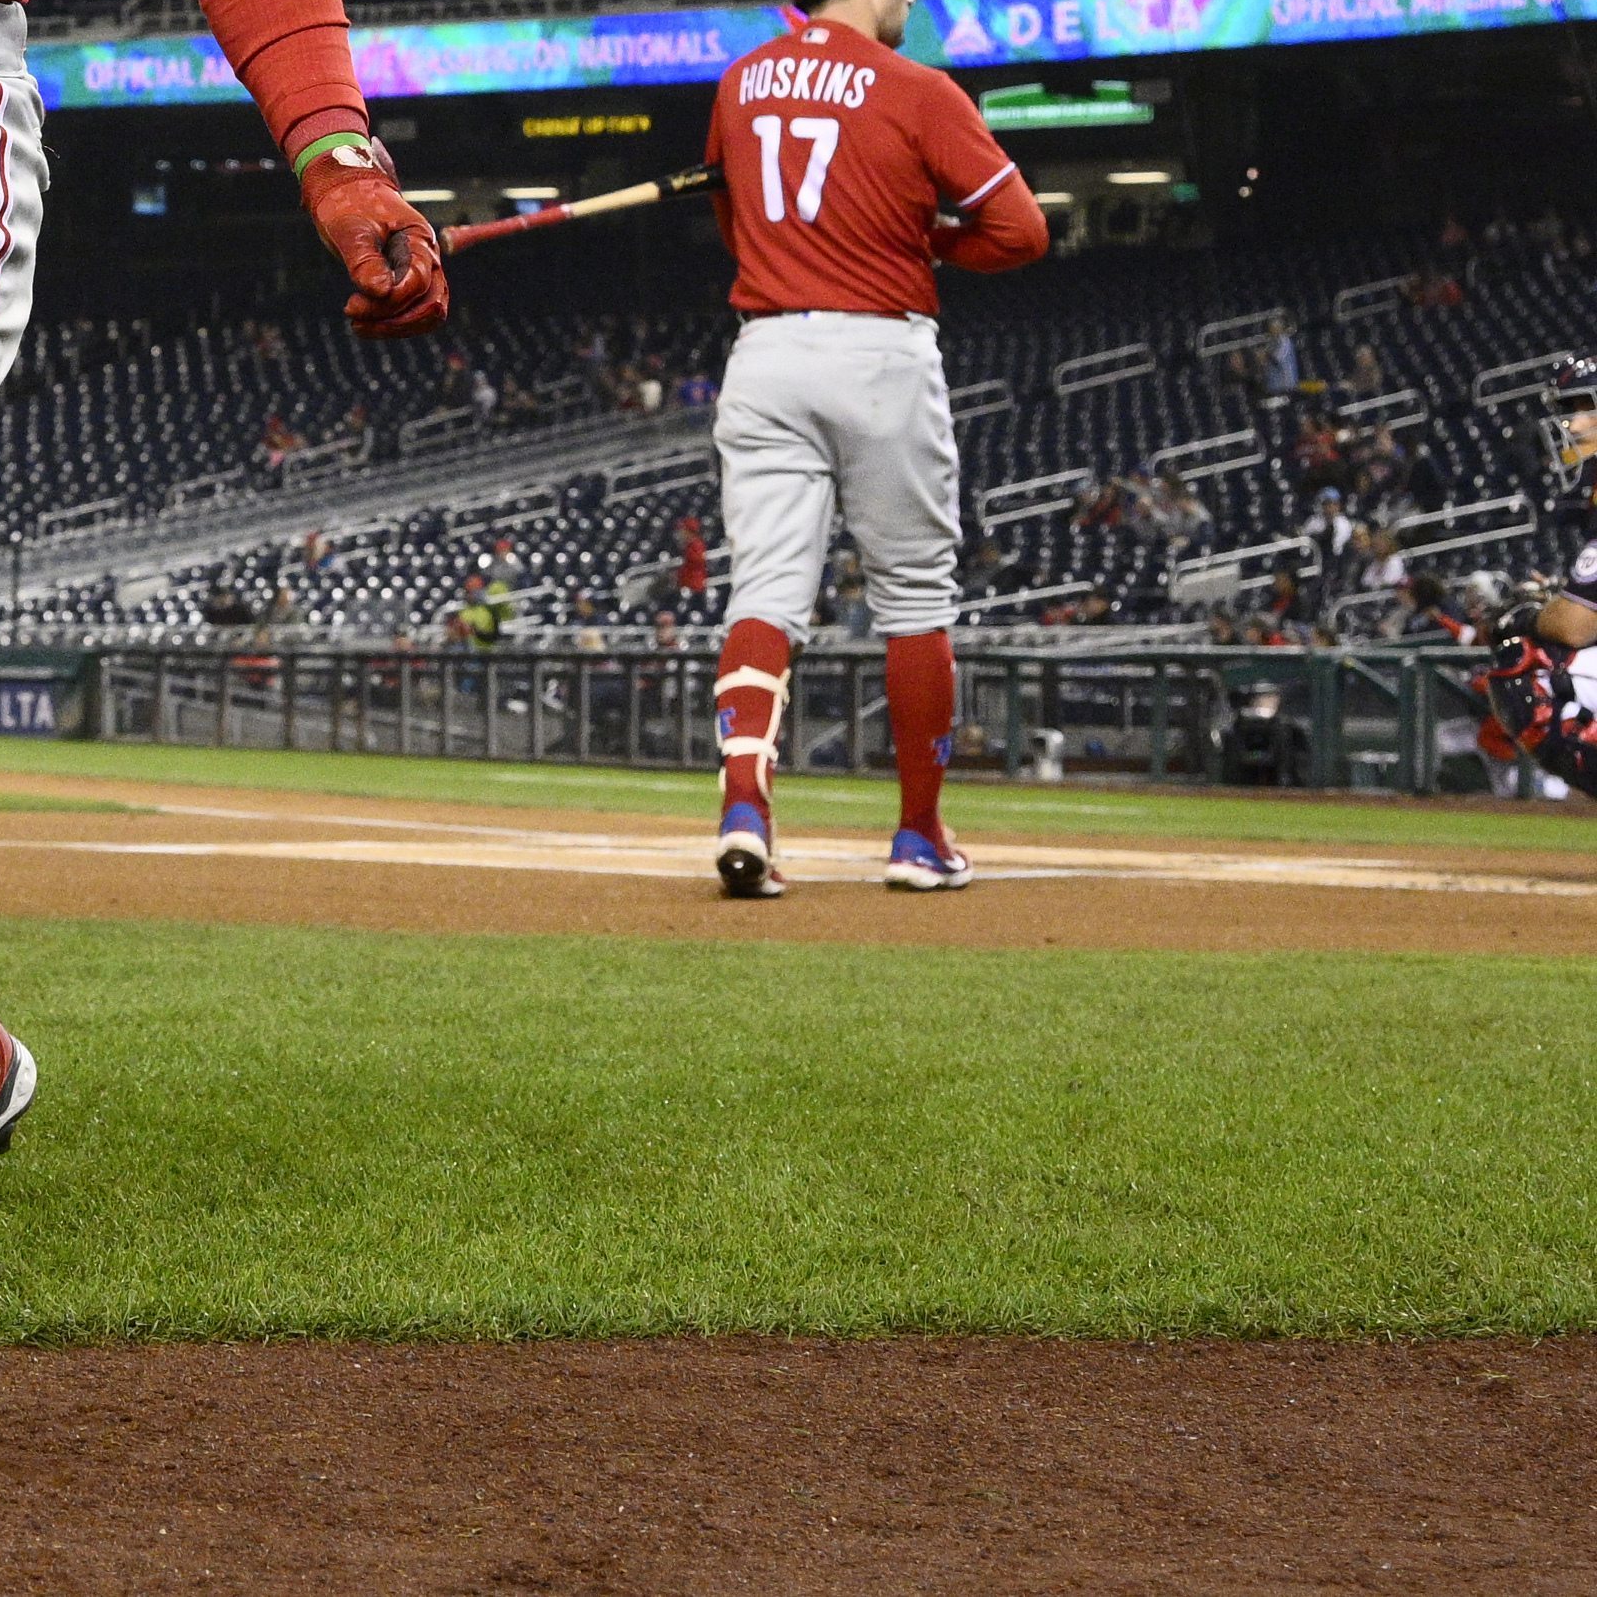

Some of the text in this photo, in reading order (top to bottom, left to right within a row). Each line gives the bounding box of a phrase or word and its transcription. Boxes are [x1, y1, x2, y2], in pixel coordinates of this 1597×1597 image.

[85, 56, 195, 91] OFFICIAL
[738, 57, 876, 108] HOSKINS
[752, 114, 840, 224] 17
